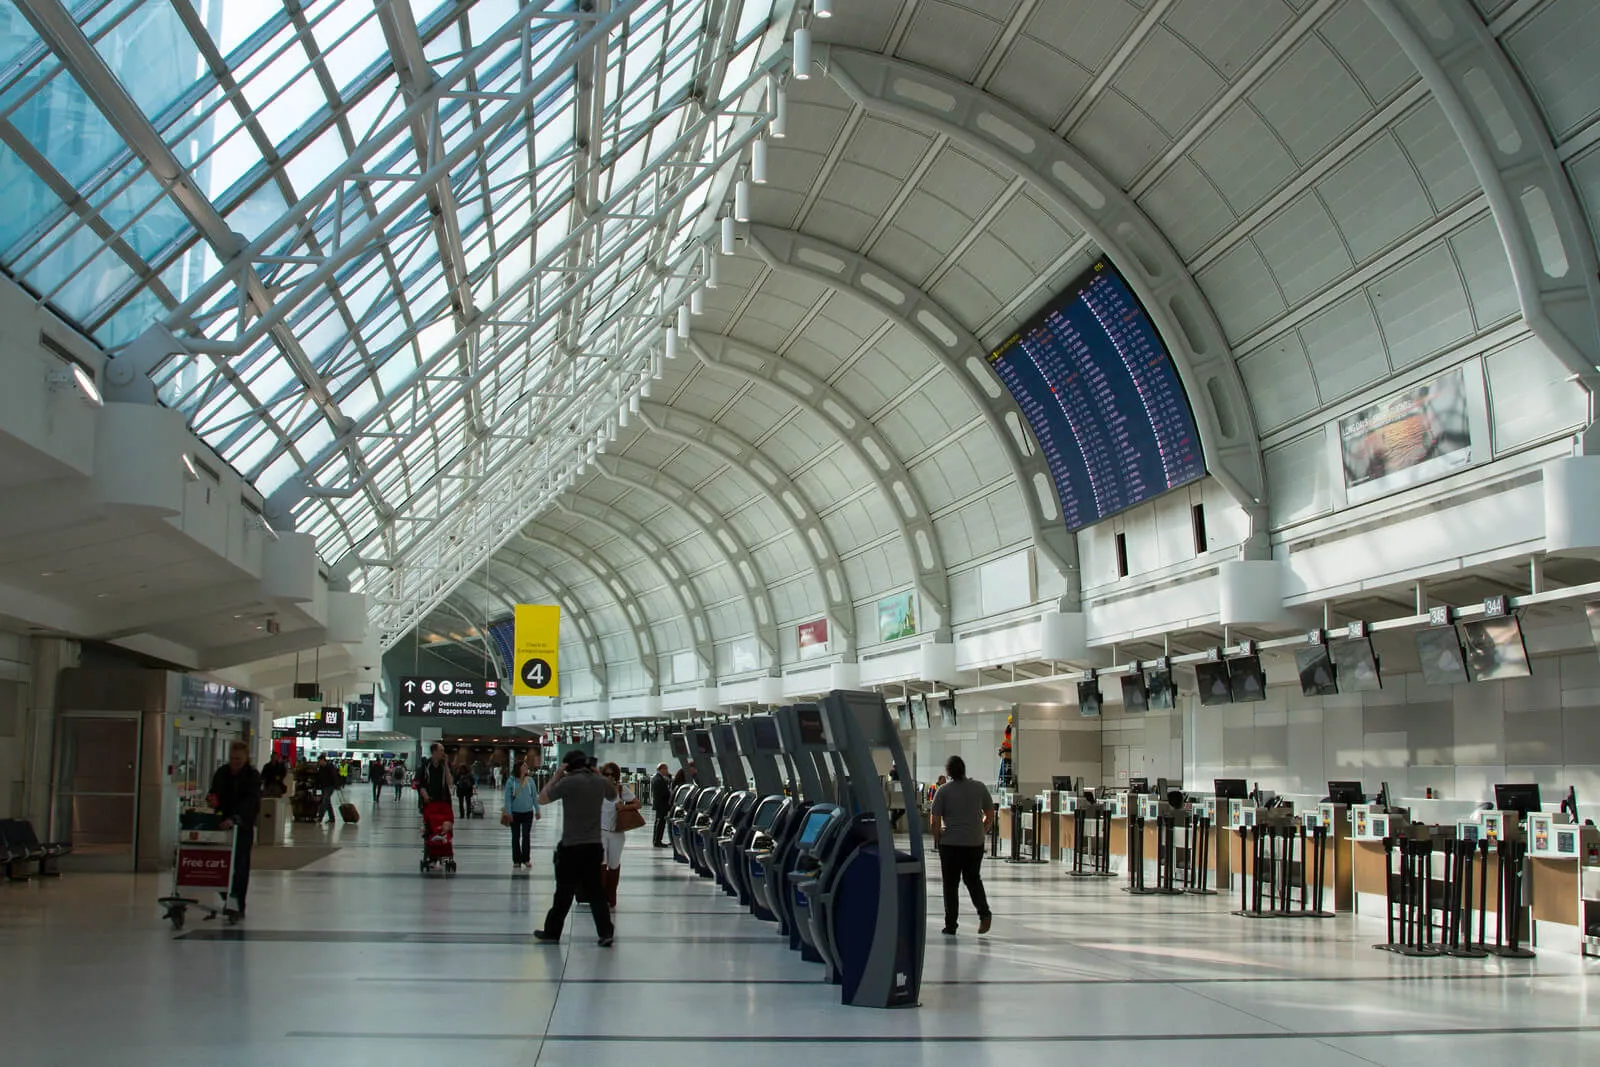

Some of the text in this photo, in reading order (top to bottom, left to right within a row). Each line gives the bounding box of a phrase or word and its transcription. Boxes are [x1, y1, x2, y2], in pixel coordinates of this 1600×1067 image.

[1486, 599, 1501, 614] 344
[1431, 609, 1446, 624] 345
[527, 663, 544, 685] 4
[438, 707, 462, 715] Bagages
[182, 857, 228, 869] Free cart.
